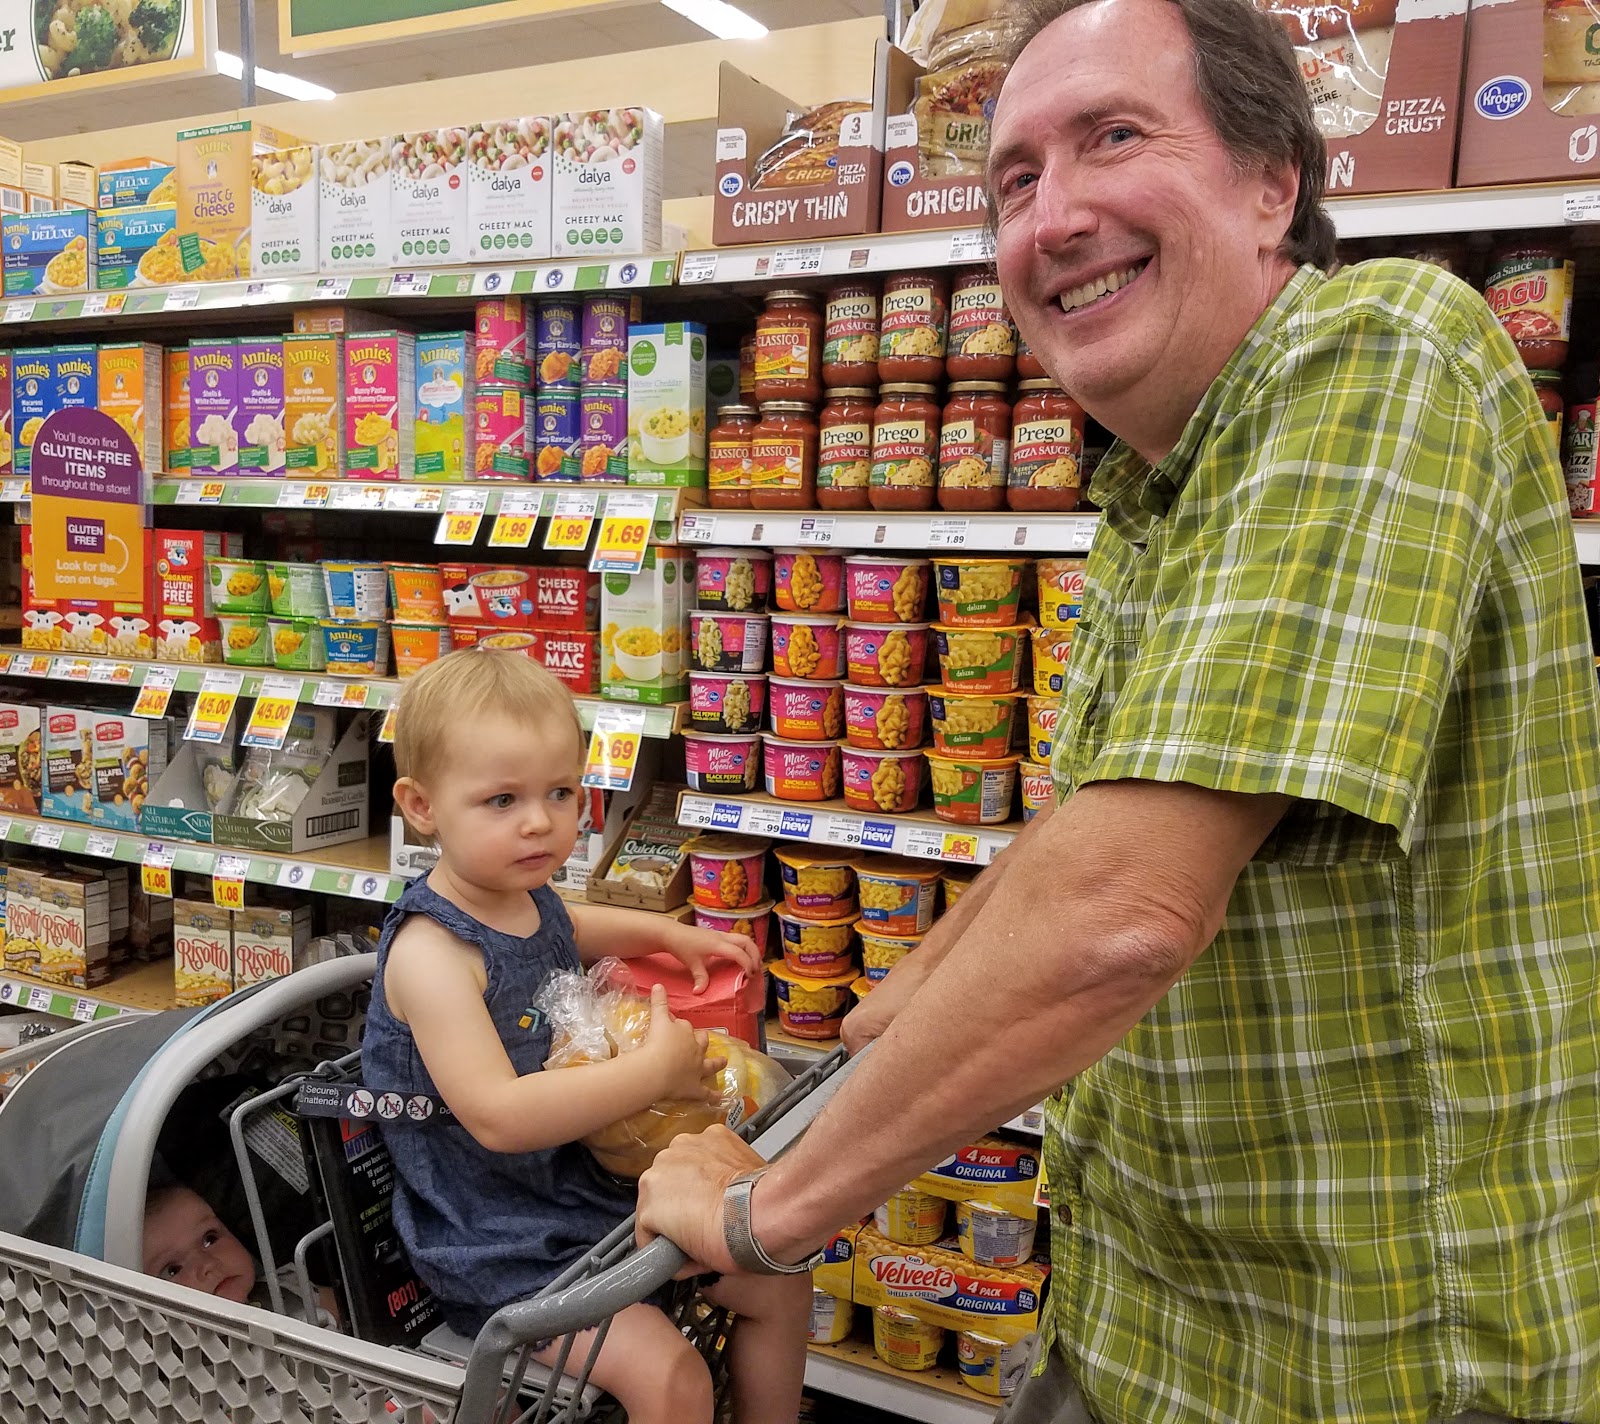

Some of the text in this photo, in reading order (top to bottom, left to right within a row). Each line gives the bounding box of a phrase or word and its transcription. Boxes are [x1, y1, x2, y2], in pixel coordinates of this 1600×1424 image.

[1386, 96, 1446, 117] PIZZA
[1482, 86, 1523, 113] Kroger
[852, 116, 862, 134] 3
[1384, 115, 1446, 135] CRUST
[838, 163, 866, 174] PIZZA
[115, 177, 150, 189] DELUXE
[491, 176, 521, 192] daiya
[578, 169, 611, 185] daiya
[838, 174, 866, 185] CRUST
[197, 190, 224, 204] mac
[412, 185, 440, 201] daiya
[268, 200, 293, 216] daiya
[340, 193, 367, 209] daiya
[906, 186, 988, 218] ORIGIN
[194, 202, 235, 218] cheese
[732, 191, 848, 227] CRISPY THIN
[479, 219, 533, 231] CHEEZY MAC
[565, 214, 624, 225] CHEEZY MAC
[31, 228, 75, 241] DELUXE
[124, 223, 167, 237] DELUXE
[400, 226, 451, 238] CHEEZY MAC
[261, 238, 300, 249] CHEEZY MAC
[331, 233, 375, 243] CHEEZY MAC
[800, 261, 819, 270] 2.59
[1502, 261, 1533, 277] Sauce
[412, 283, 428, 293] 4.69
[885, 295, 924, 312] Prego
[954, 292, 996, 310] Prego
[543, 308, 574, 321] Annie's
[591, 302, 626, 318] Annie's
[829, 303, 870, 320] Prego
[882, 314, 931, 330] PIZZA SAUCE
[951, 312, 1002, 330] PIZZA SAUCE
[826, 321, 876, 338] PIZZA SAUCE
[757, 334, 799, 347] CLASSICO
[193, 349, 234, 371] Annie's
[242, 348, 284, 370] Annie's
[288, 346, 331, 366] Annie's
[349, 343, 393, 366] Annie's
[420, 344, 461, 367] Annie's
[16, 360, 50, 379] Annie's
[57, 357, 92, 377] Annie's
[539, 402, 567, 416] Annie's
[584, 400, 614, 414] Annie's
[53, 429, 119, 449] You'll soon find
[823, 430, 863, 446] Prego
[877, 427, 919, 444] Prego
[1018, 426, 1065, 444] Prego
[40, 443, 132, 467] GLUTEN-FREE
[820, 448, 870, 462] PIZZA SAUCE
[874, 446, 925, 460] PIZZA SAUCE
[947, 446, 975, 456] SAUCE
[1013, 445, 1070, 461] PIZZA SAUCE
[65, 462, 107, 479] ITEMS
[42, 475, 131, 496] throughout the store!
[203, 482, 222, 496] 1.59
[308, 484, 328, 498] 1.59
[468, 501, 484, 510] 2.79
[523, 503, 539, 511] 2.79
[579, 504, 594, 513] 2.79
[68, 523, 103, 537] GLUTEN
[499, 521, 527, 538] 1.99
[555, 523, 583, 540] 1.99
[607, 524, 645, 545] 1.69
[74, 535, 98, 547] FREE
[814, 532, 831, 542] 1.89
[946, 535, 964, 544] 1.89
[56, 558, 117, 573] Look for the
[55, 573, 91, 585] icon on
[538, 577, 580, 589] CHEESY
[854, 571, 877, 585] Mac
[164, 581, 193, 590] GLUTEN
[164, 590, 193, 603] FREE
[481, 586, 521, 600] HORIZON
[538, 589, 579, 605] MAC
[966, 603, 988, 611] deluxe
[329, 631, 364, 643] Annie's
[545, 641, 586, 653] CHEESY
[545, 653, 585, 669] MAC
[956, 669, 974, 677] deluxe
[200, 697, 231, 715] 4/5.00
[785, 693, 808, 705] Mac
[257, 702, 291, 721] 4/5.00
[786, 707, 812, 718] Cheese
[708, 748, 731, 761] Mac
[784, 754, 807, 767] Mac
[97, 768, 124, 779] FALAFEL
[710, 762, 734, 772] Cheese
[785, 768, 810, 778] Cheese
[145, 807, 156, 816] ALL
[712, 812, 740, 823] new
[145, 815, 177, 825] NATURAL
[191, 818, 212, 828] NEW
[218, 815, 229, 824] ALL
[695, 815, 711, 824] .99
[782, 821, 810, 832] new
[217, 824, 250, 835] NATURAL
[763, 824, 780, 833] .99
[843, 833, 860, 843] .99
[862, 830, 892, 843] new
[624, 840, 656, 855] Quick
[923, 846, 941, 856] .89
[568, 865, 592, 874] CULINAR
[146, 873, 166, 889] 1.08
[218, 885, 239, 902] 1.08
[41, 913, 84, 948] Risotto
[177, 937, 229, 973] Risotto
[236, 943, 291, 979] Risotto
[306, 1084, 340, 1098] Securely
[299, 1095, 344, 1107] nattende
[966, 1149, 1002, 1165] 4 PACK
[955, 1165, 1007, 1179] ORIGINAL
[908, 1256, 921, 1264] Kraft
[876, 1261, 954, 1288] Velveeta
[887, 1289, 938, 1299] SHELLS CHEESE
[966, 1281, 1002, 1298] 4 PACK
[388, 1280, 419, 1317] (801)
[956, 1297, 1007, 1312] ORIGINAL
[417, 1312, 427, 1324] 300
